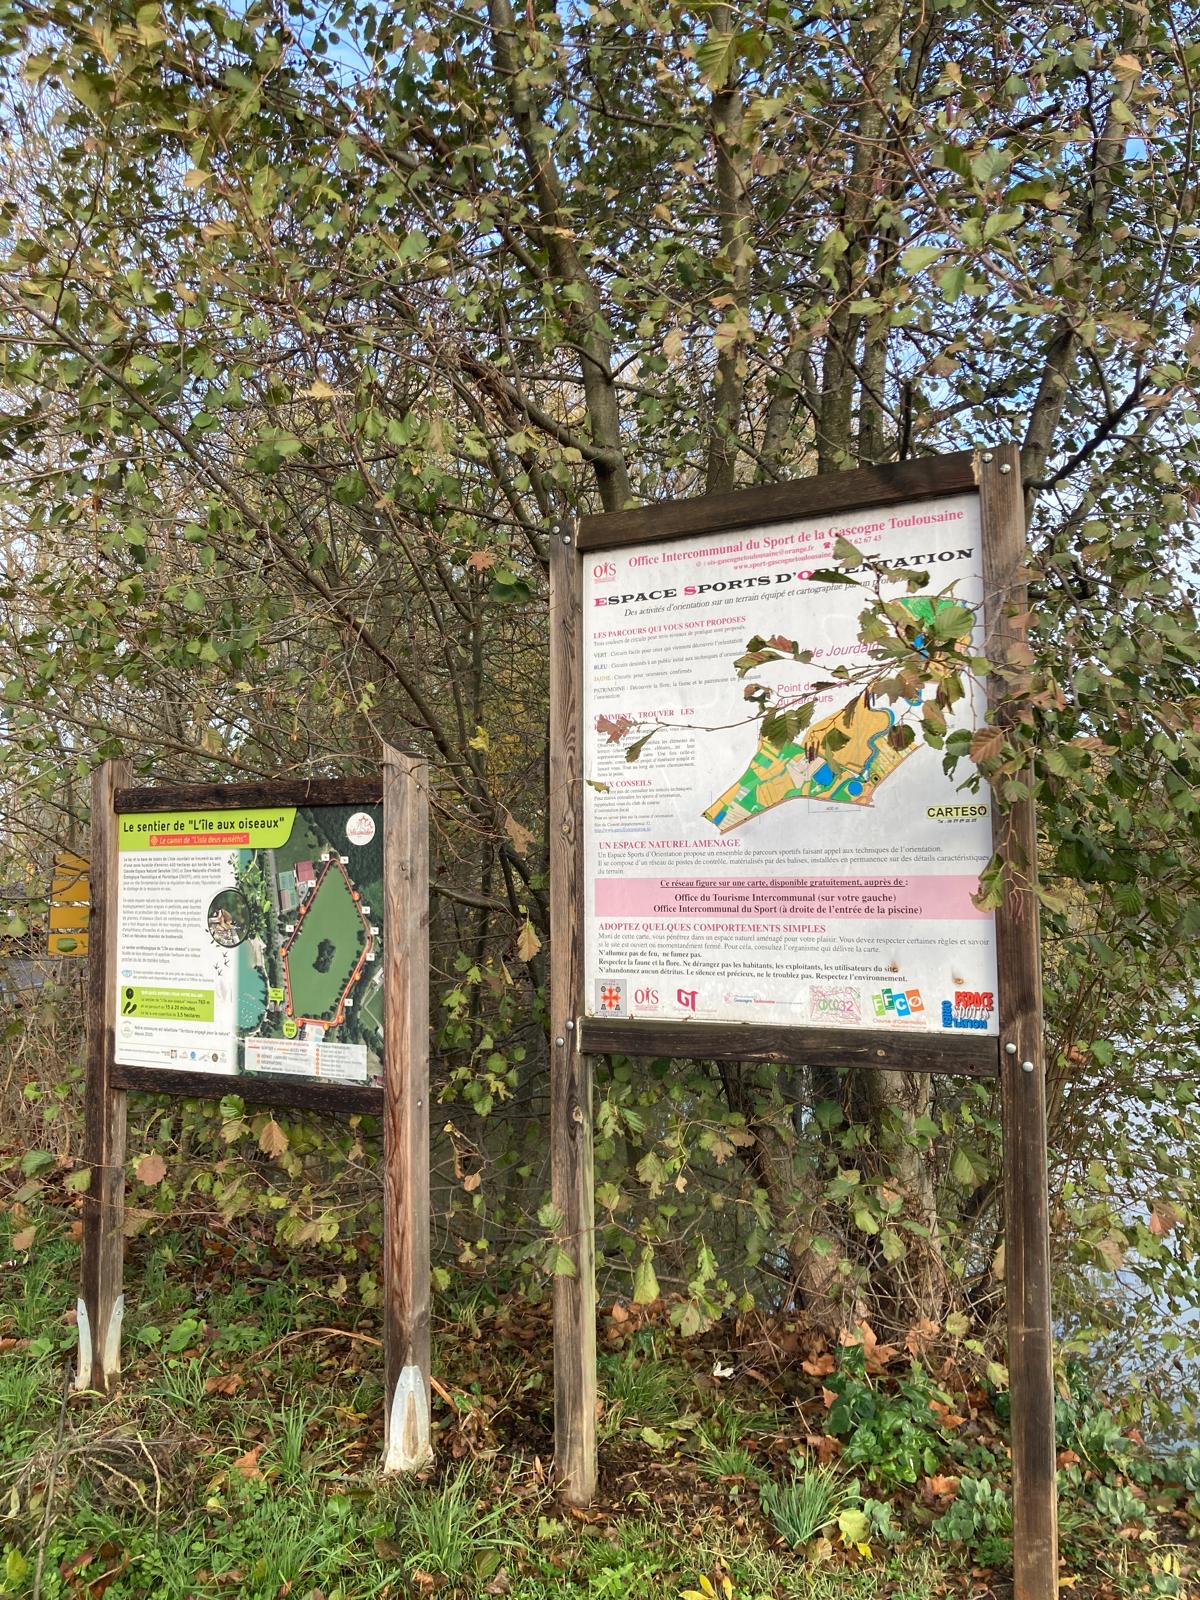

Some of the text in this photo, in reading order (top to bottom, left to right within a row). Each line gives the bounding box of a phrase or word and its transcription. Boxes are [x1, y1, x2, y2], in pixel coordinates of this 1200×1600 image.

[629, 511, 963, 567] Office Intercommunal du Sport de la Gascogne Toulousaine
[594, 588, 678, 608] ESPACE
[684, 576, 771, 596] SPORTS
[776, 548, 976, 583] D'OIENTATION
[624, 607, 638, 616] Des
[639, 604, 665, 615] activités
[666, 599, 710, 612] d'orientation
[735, 593, 759, 604] terrain
[760, 590, 786, 603] équipé
[593, 615, 746, 640] LES PARCOURS QUI VOUS SONT PROPOSES
[778, 684, 801, 692] Point
[792, 694, 834, 706] parcurs
[638, 710, 674, 718] TROUVER
[680, 708, 695, 716] LES
[616, 780, 652, 788] CONSEILS
[928, 806, 987, 818] CARTESO
[123, 818, 284, 833] Le sentier de "L'île aux oiseaux"
[599, 839, 740, 849] UN ESPACE NATUREL AMENAGE
[660, 879, 671, 887] Ce
[671, 879, 694, 887] réseau
[695, 879, 718, 887] figure
[746, 879, 768, 887] carte,
[769, 878, 808, 886] disponible
[809, 878, 862, 886] gratuitement,
[864, 878, 891, 886] auprès
[893, 878, 903, 886] de
[674, 894, 896, 904] Office du Tourisme Intercommunal (sur votre gauche)
[653, 905, 677, 913] Office
[679, 905, 739, 913] Intercommunal
[741, 905, 752, 913] du
[753, 905, 778, 915] Sport
[778, 905, 788, 915] (à
[789, 905, 815, 913] droite
[829, 906, 862, 914] l'entrée
[864, 906, 875, 914] de
[877, 906, 886, 914] la
[887, 906, 922, 916] piscine)
[599, 923, 826, 933] ADOPTEZ QUELQUES COMPORTEMENTS SIMPLES
[599, 949, 627, 957] N'allumez
[648, 950, 659, 959] feu,
[670, 950, 688, 958] fumez
[690, 952, 702, 960] pas.
[599, 958, 626, 967] Respectez
[692, 960, 720, 970] dérangez
[742, 962, 774, 971] habitants,
[785, 963, 823, 972] exploitants,
[834, 964, 872, 972] utilisateurs
[599, 967, 640, 975] N'abandonnez
[660, 968, 684, 976] détritus.
[727, 970, 755, 980] précieux,
[815, 973, 848, 982] Respectez
[849, 974, 908, 982] l'environnement.
